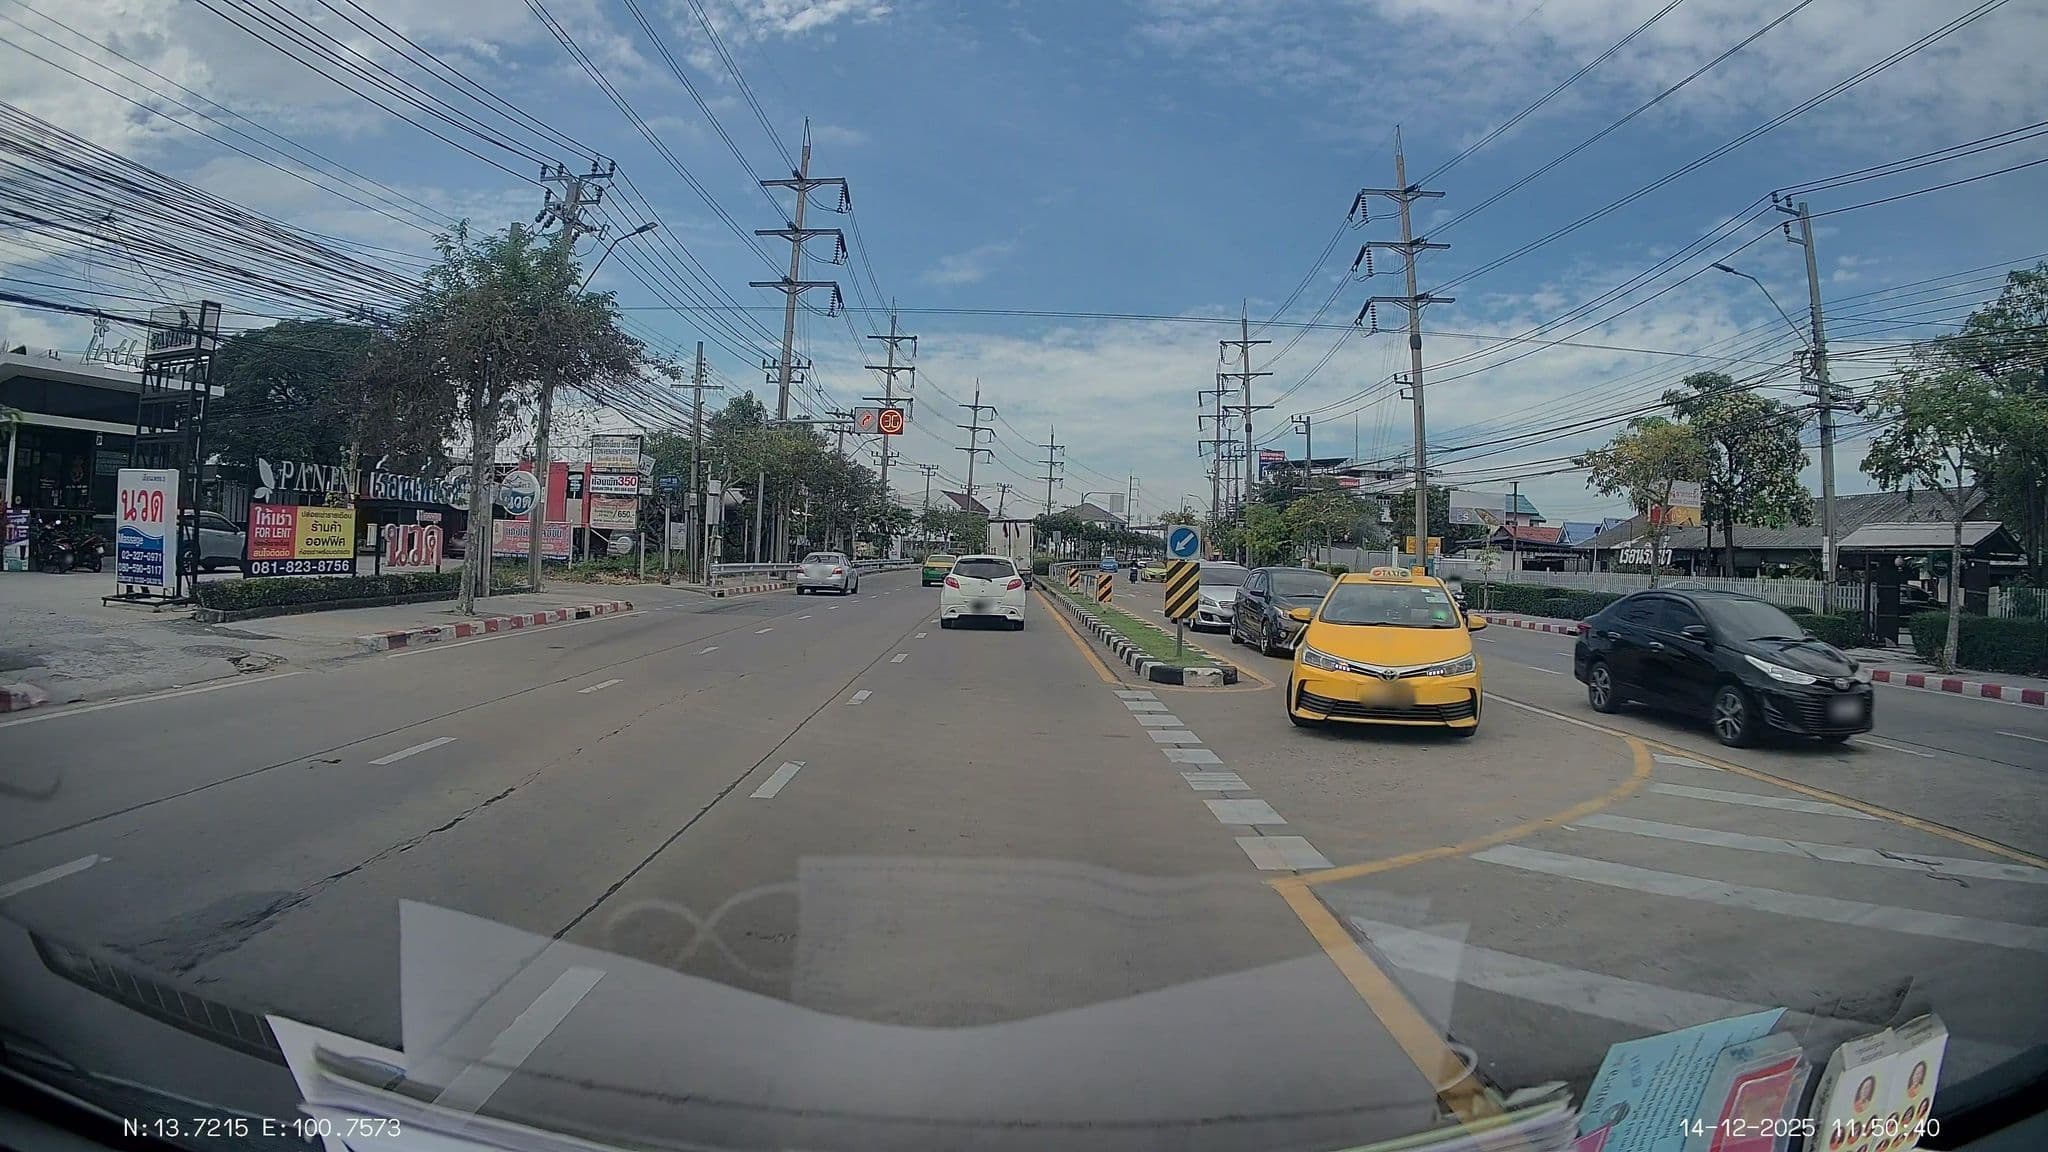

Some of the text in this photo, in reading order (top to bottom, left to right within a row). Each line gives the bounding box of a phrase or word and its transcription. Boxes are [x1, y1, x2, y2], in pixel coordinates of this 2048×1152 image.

[884, 414, 899, 428] 30
[121, 489, 163, 522] นวด
[255, 507, 292, 525] ให้เช่า
[255, 527, 292, 538] FOR LENT
[311, 520, 342, 532] ร้านค้า
[253, 547, 290, 557] สนใจติดต่อ
[385, 523, 444, 567] นวด
[251, 560, 350, 574] 081-823-8756
[1382, 570, 1400, 578] TAXI
